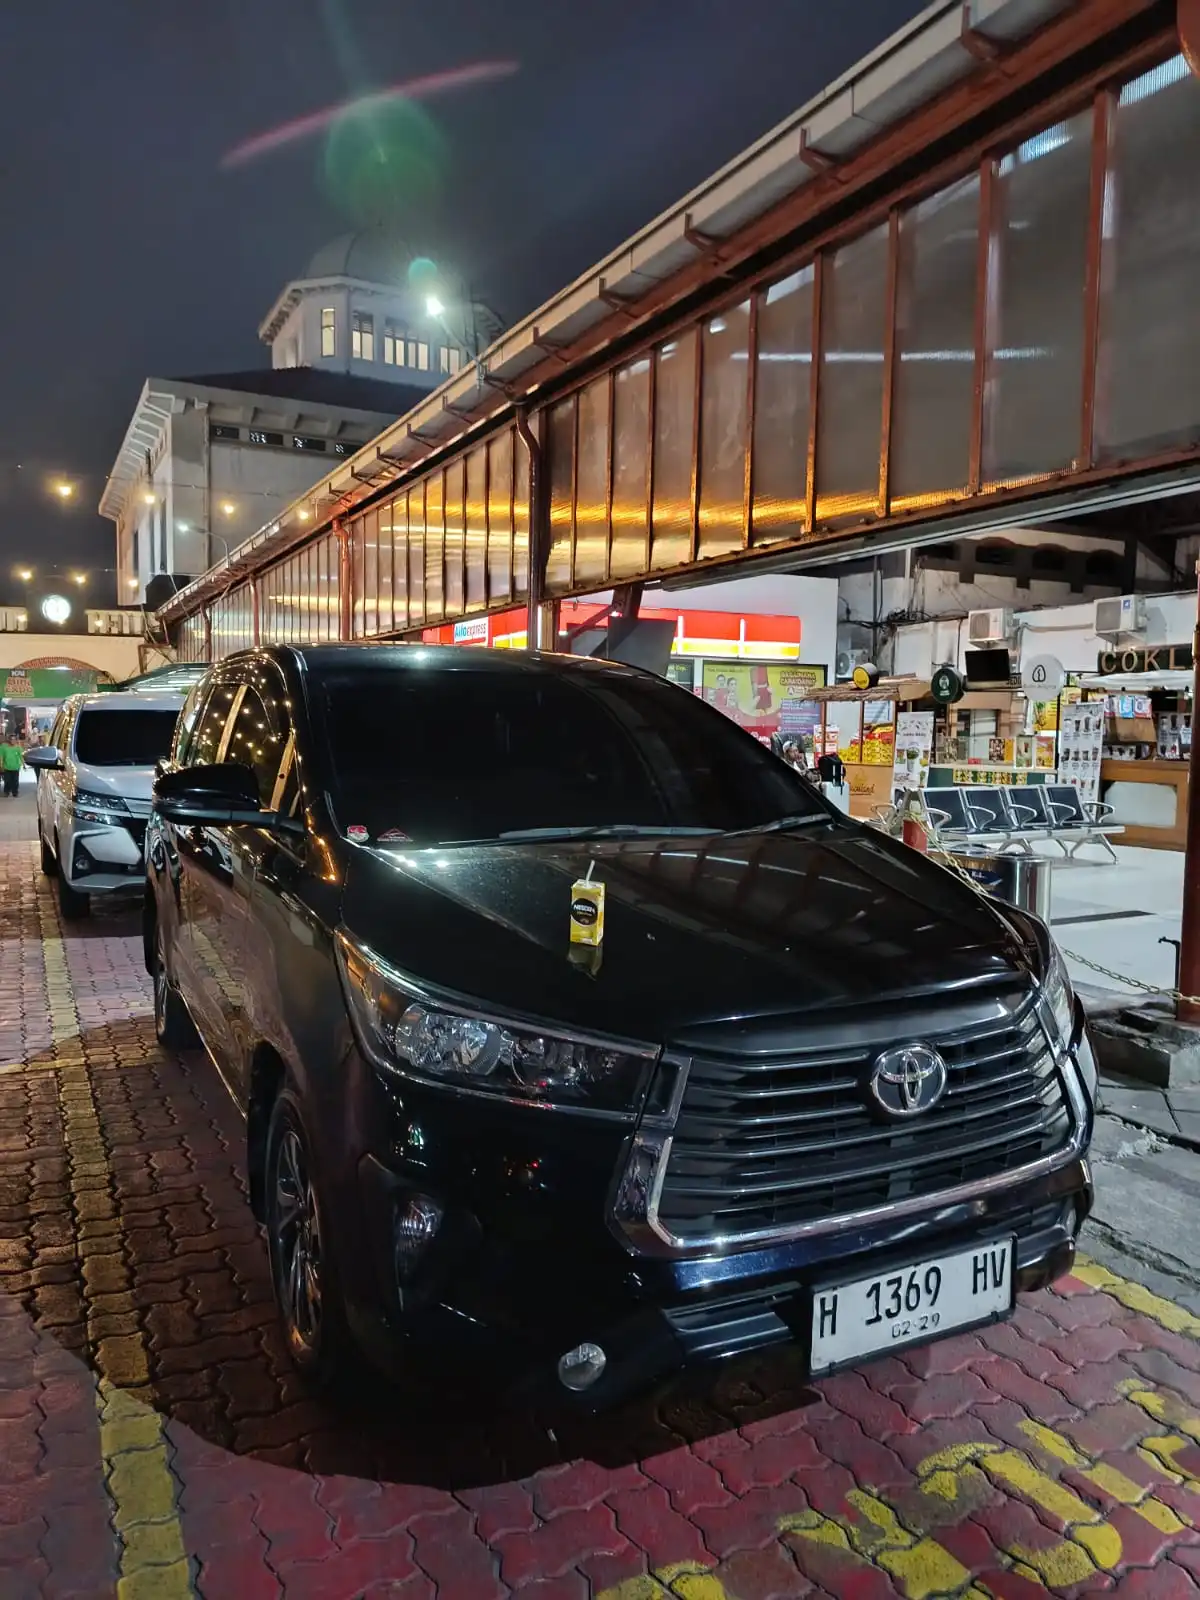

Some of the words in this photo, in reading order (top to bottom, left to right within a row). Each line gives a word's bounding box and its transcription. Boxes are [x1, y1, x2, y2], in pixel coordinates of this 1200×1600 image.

[819, 1294, 838, 1338] H
[865, 1266, 942, 1326] 1369
[972, 1248, 1006, 1295] HV
